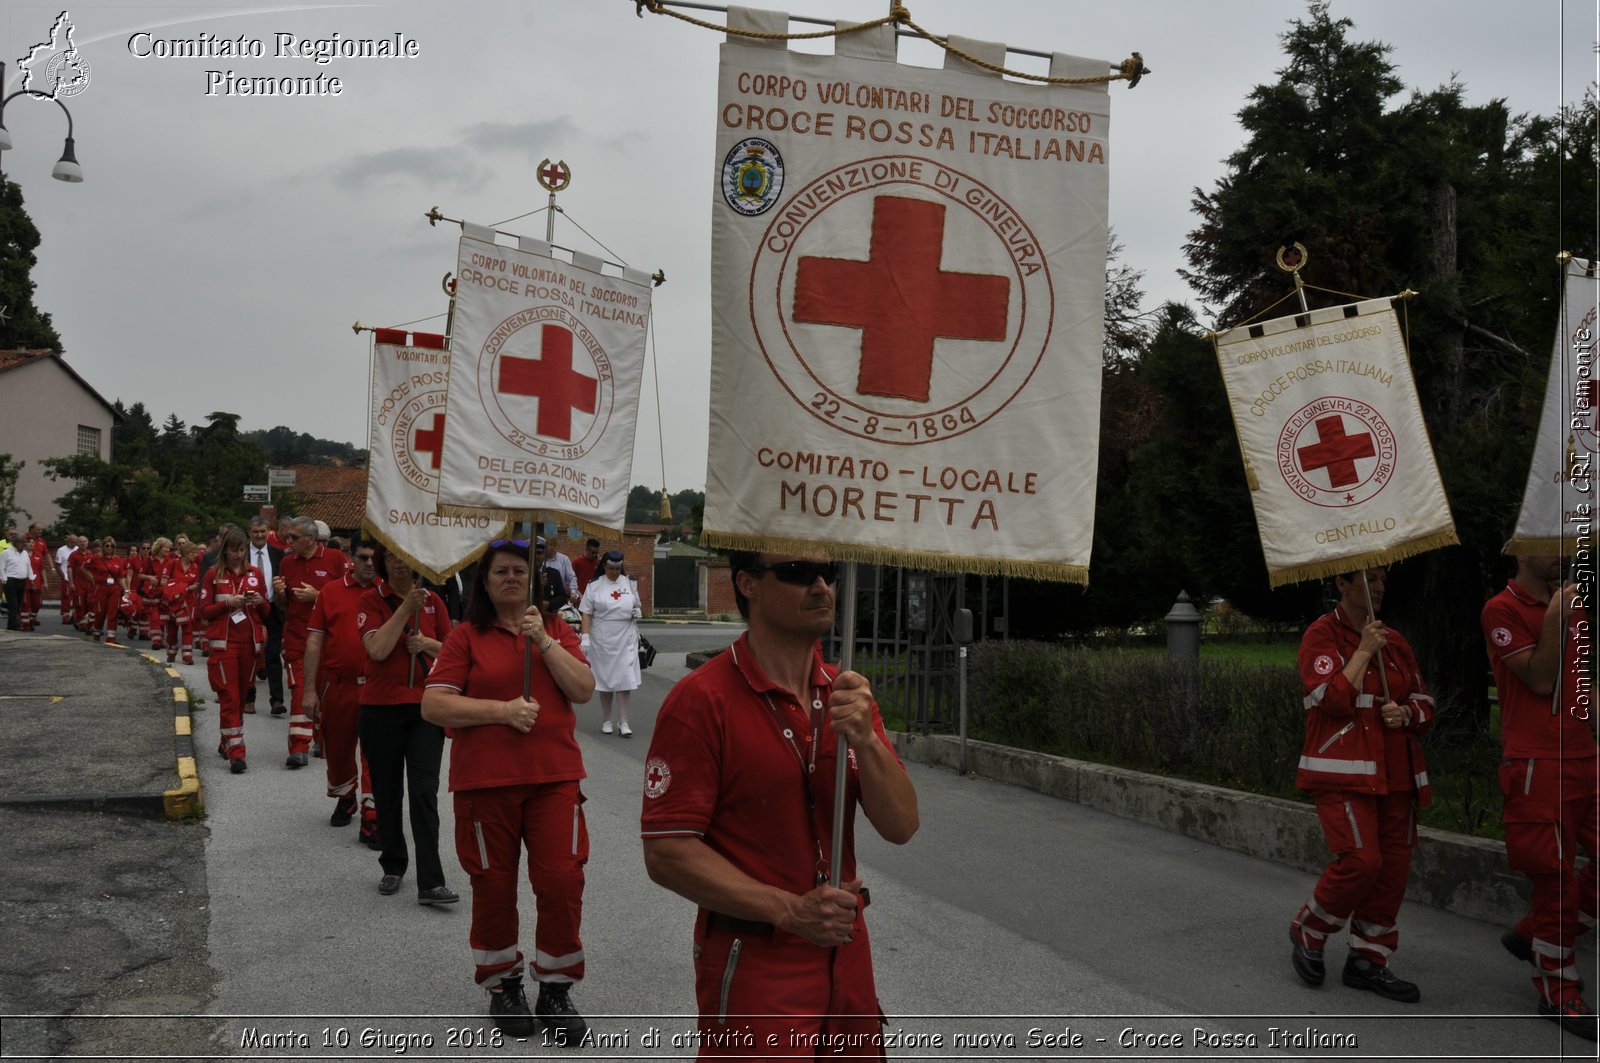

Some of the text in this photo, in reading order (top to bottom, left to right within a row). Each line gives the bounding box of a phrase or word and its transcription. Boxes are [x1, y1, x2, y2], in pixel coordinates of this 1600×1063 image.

[738, 72, 1092, 134] CORPO VOLONTARI DEL SOCCORSO
[723, 103, 1104, 164] CROCE ROSSA ITALIANA
[768, 161, 1042, 276] CONVENZIONE DI GINEVRA
[461, 268, 645, 328] CROCE ROSSA ITALIANA
[472, 253, 638, 308] CORPO VOLONTARI DEL SOCCORSO
[396, 350, 438, 364] VOLONTARI
[485, 308, 611, 382] CONVENZIONE DI GINEVRA
[1238, 325, 1382, 365] CORPO VOLONTARI DEL SOCCORSO
[377, 382, 411, 426] CROCE
[411, 402, 424, 412] DI
[1250, 359, 1394, 417] CROCE ROSSA ITALIANA
[394, 412, 430, 488] CONVENZIONE
[478, 455, 606, 490] DELEGAZIONE DI
[757, 447, 889, 482] COMITATO
[922, 466, 1038, 495] LOCALE
[1280, 400, 1392, 499] CONVENZIONE DI GINEVRA 22 AGOSTO 1864
[482, 475, 600, 509] PEVERAGNO
[780, 480, 999, 531] MORETTA
[388, 509, 490, 529] SAVIGLIANO
[1315, 517, 1396, 545] CENTALLO
